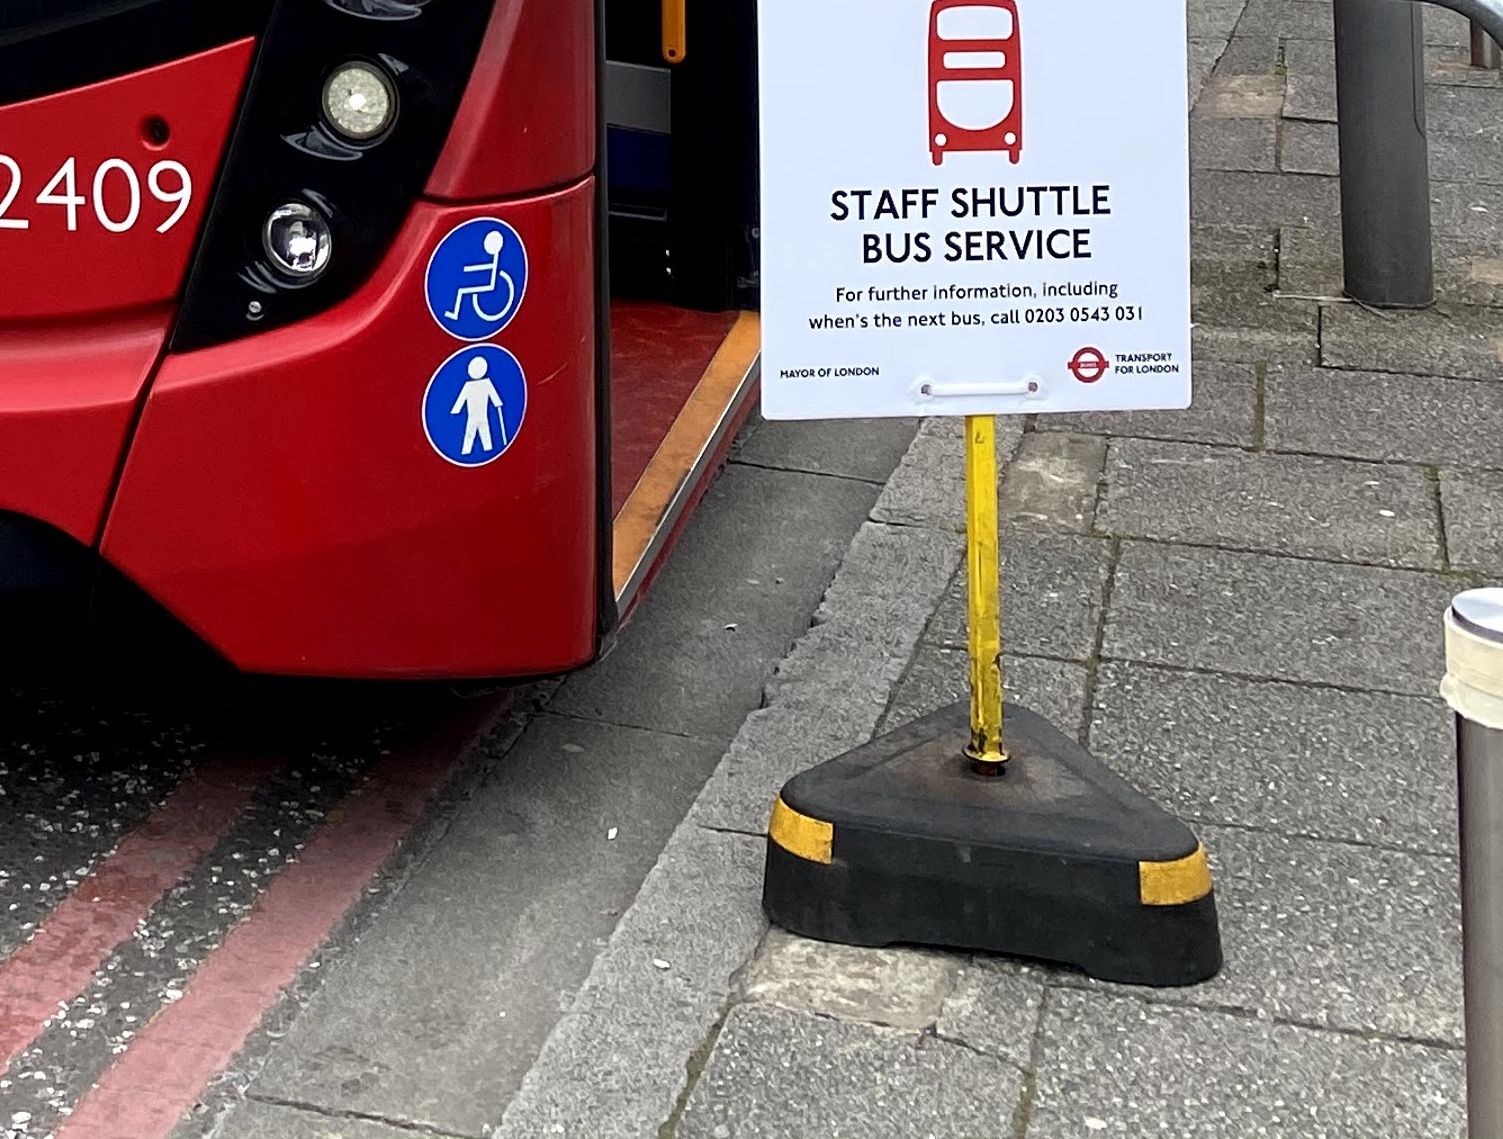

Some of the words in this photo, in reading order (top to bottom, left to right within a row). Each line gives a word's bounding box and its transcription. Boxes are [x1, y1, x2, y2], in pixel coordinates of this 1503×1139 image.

[830, 188, 939, 221] STAFF
[951, 185, 1112, 218] SHUTTLE
[863, 232, 932, 264] BUS
[944, 228, 1092, 261] SERVICE
[836, 287, 864, 303] For
[868, 285, 928, 302] further
[933, 283, 1037, 300] information,
[1043, 281, 1119, 298] including
[809, 313, 869, 329] when's
[873, 313, 902, 328] the
[908, 312, 946, 327] next
[951, 311, 985, 327] bus,
[990, 309, 1020, 325] call
[1025, 307, 1065, 323] 0203
[1070, 306, 1110, 322] 0543
[1115, 353, 1172, 362] TRANSPORT
[780, 369, 815, 378] MAYOR
[818, 368, 832, 377] OF
[834, 366, 880, 377] LONDON
[1115, 365, 1134, 374] FOR
[1136, 364, 1179, 374] LONDON
